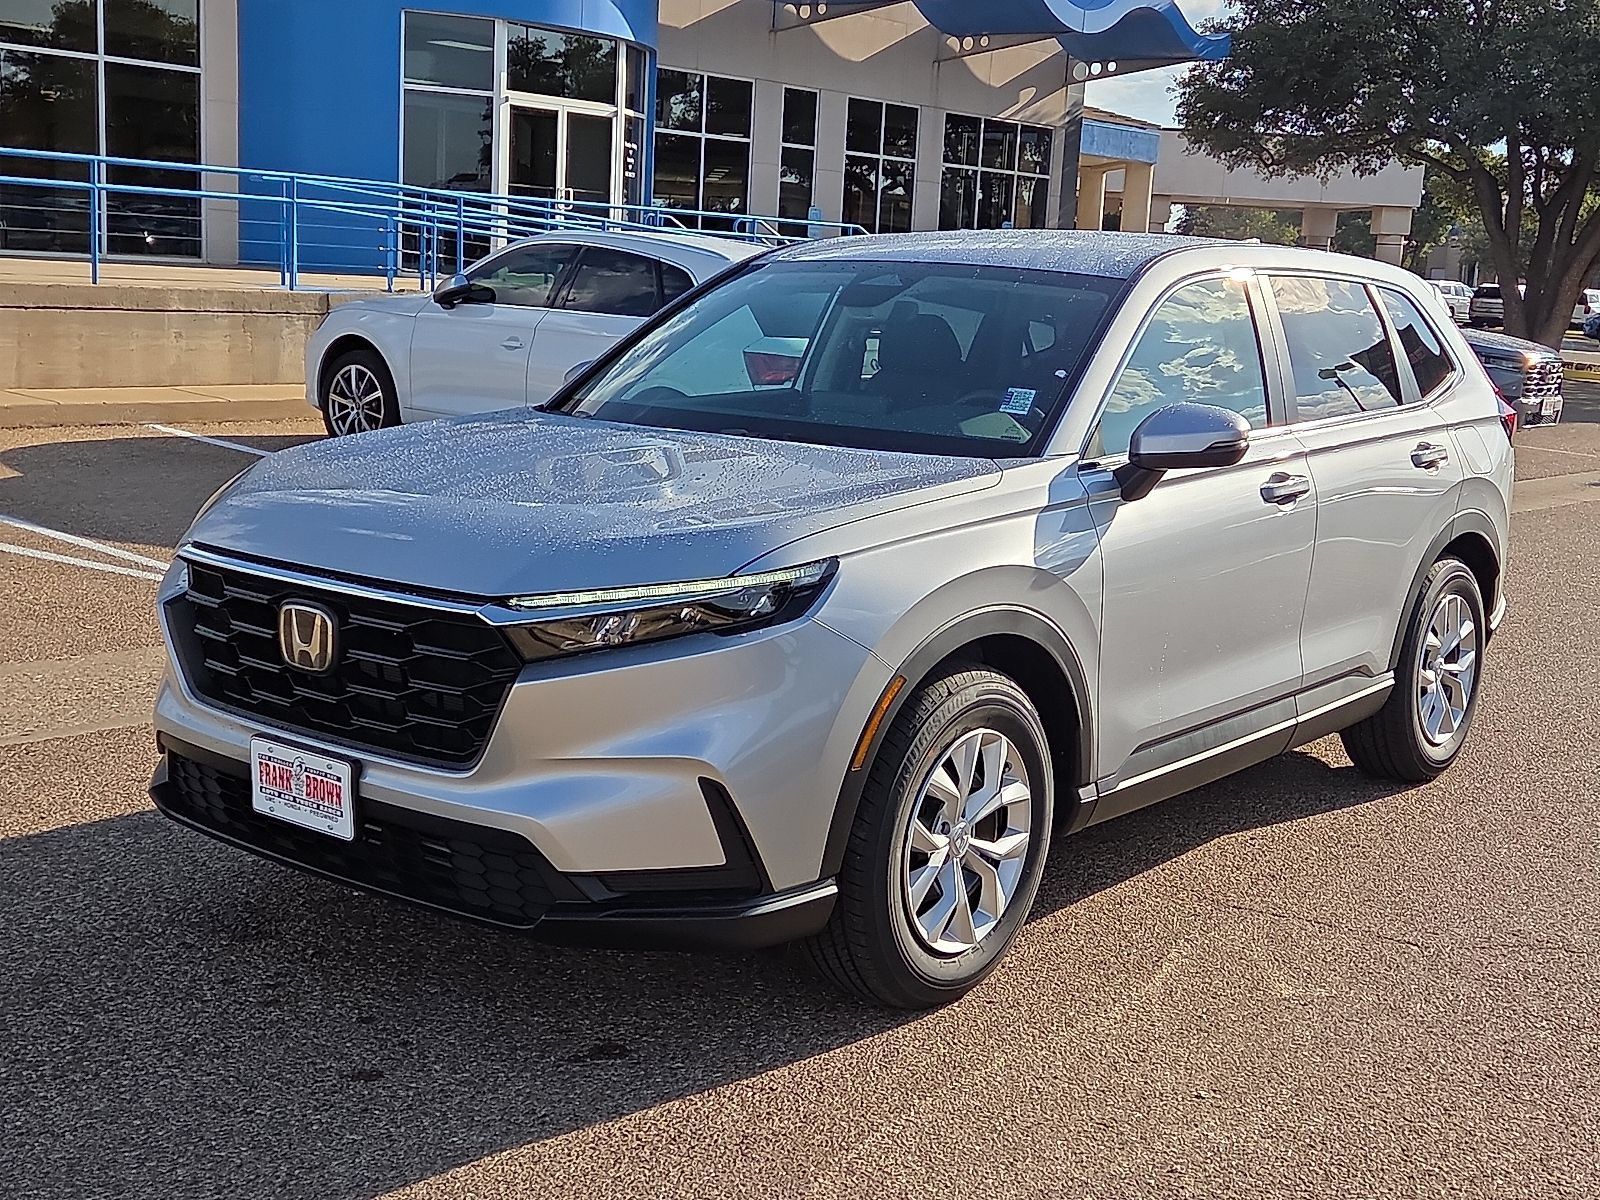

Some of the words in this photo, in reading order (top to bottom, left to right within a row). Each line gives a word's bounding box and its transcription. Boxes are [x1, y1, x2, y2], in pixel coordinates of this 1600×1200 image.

[897, 689, 973, 800] BRIDGESTONE
[259, 761, 293, 793] FRANK
[305, 775, 342, 809] BROWN
